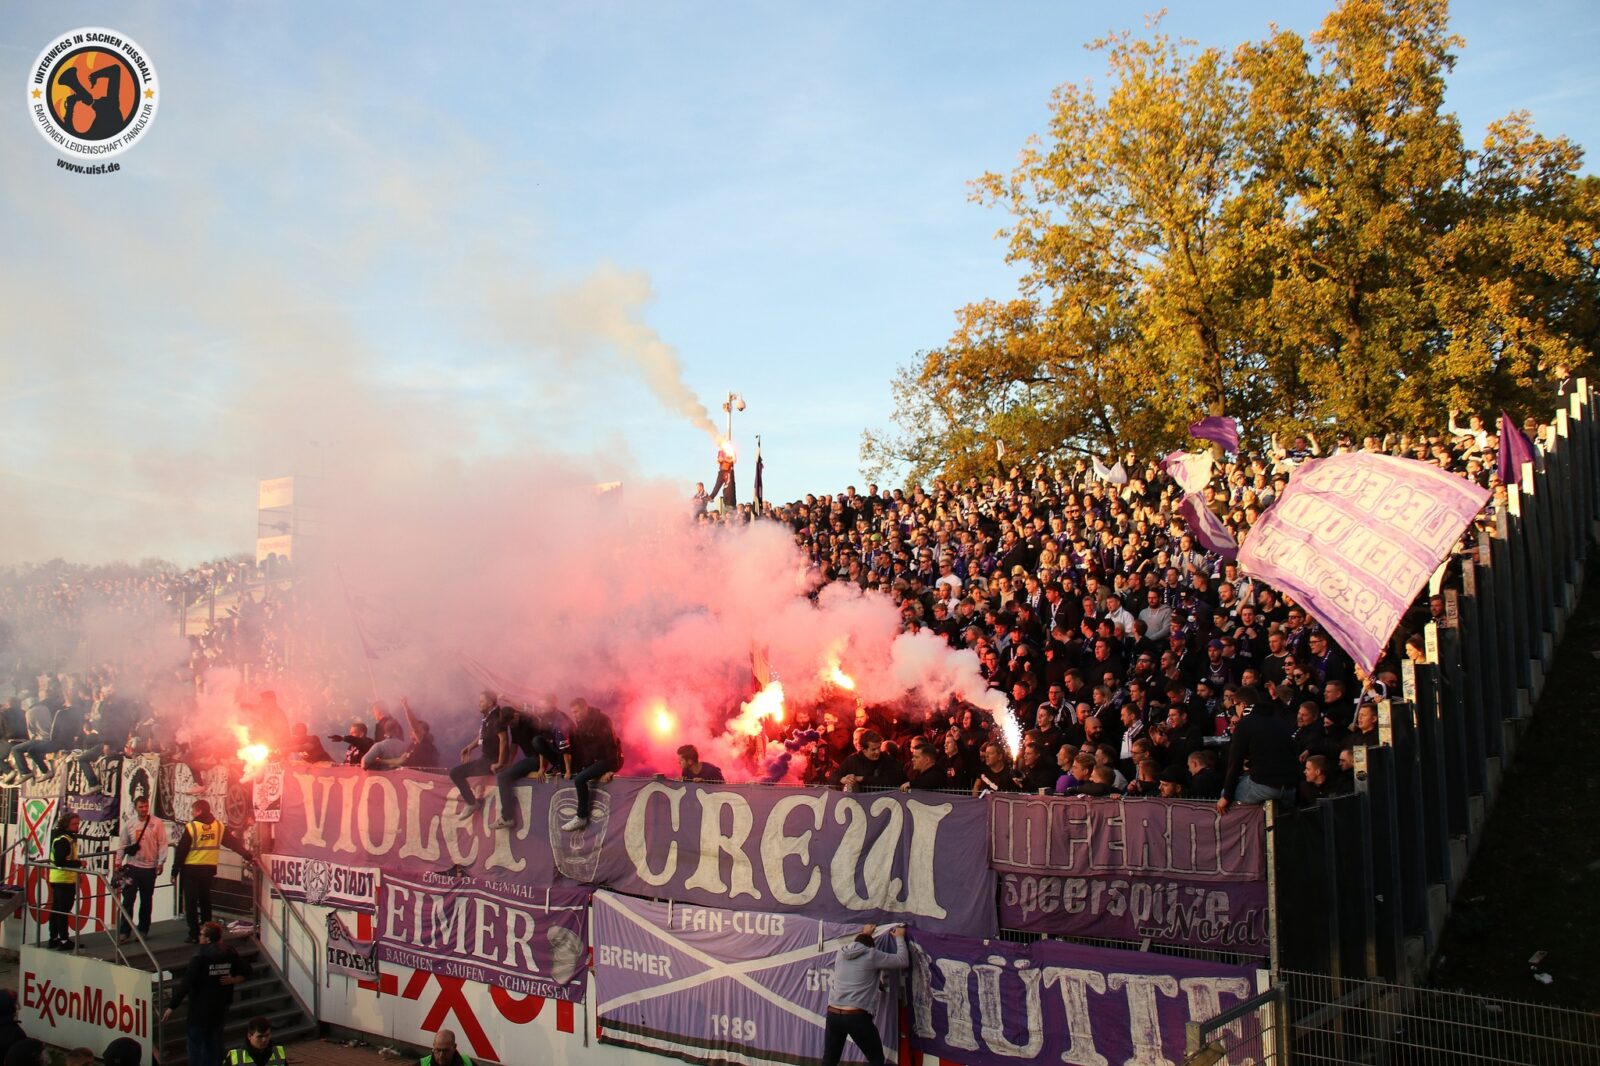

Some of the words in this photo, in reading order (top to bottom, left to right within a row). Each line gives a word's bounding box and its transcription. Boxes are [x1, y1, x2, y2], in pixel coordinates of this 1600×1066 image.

[294, 772, 532, 872] VIOLET
[624, 782, 953, 919] CREW
[271, 860, 301, 887] HASE
[333, 869, 375, 898] STADT
[385, 883, 540, 973] EIMER
[682, 908, 785, 937] FAN-CLUB
[328, 947, 375, 972] TRIER
[386, 948, 433, 971] RAUCHEN
[446, 963, 485, 983] SAUFEN
[499, 975, 571, 1000] SCHMEISSEN
[600, 944, 674, 979] BREMER
[24, 972, 147, 1038] ExxonMobil
[711, 1014, 757, 1041] 1989
